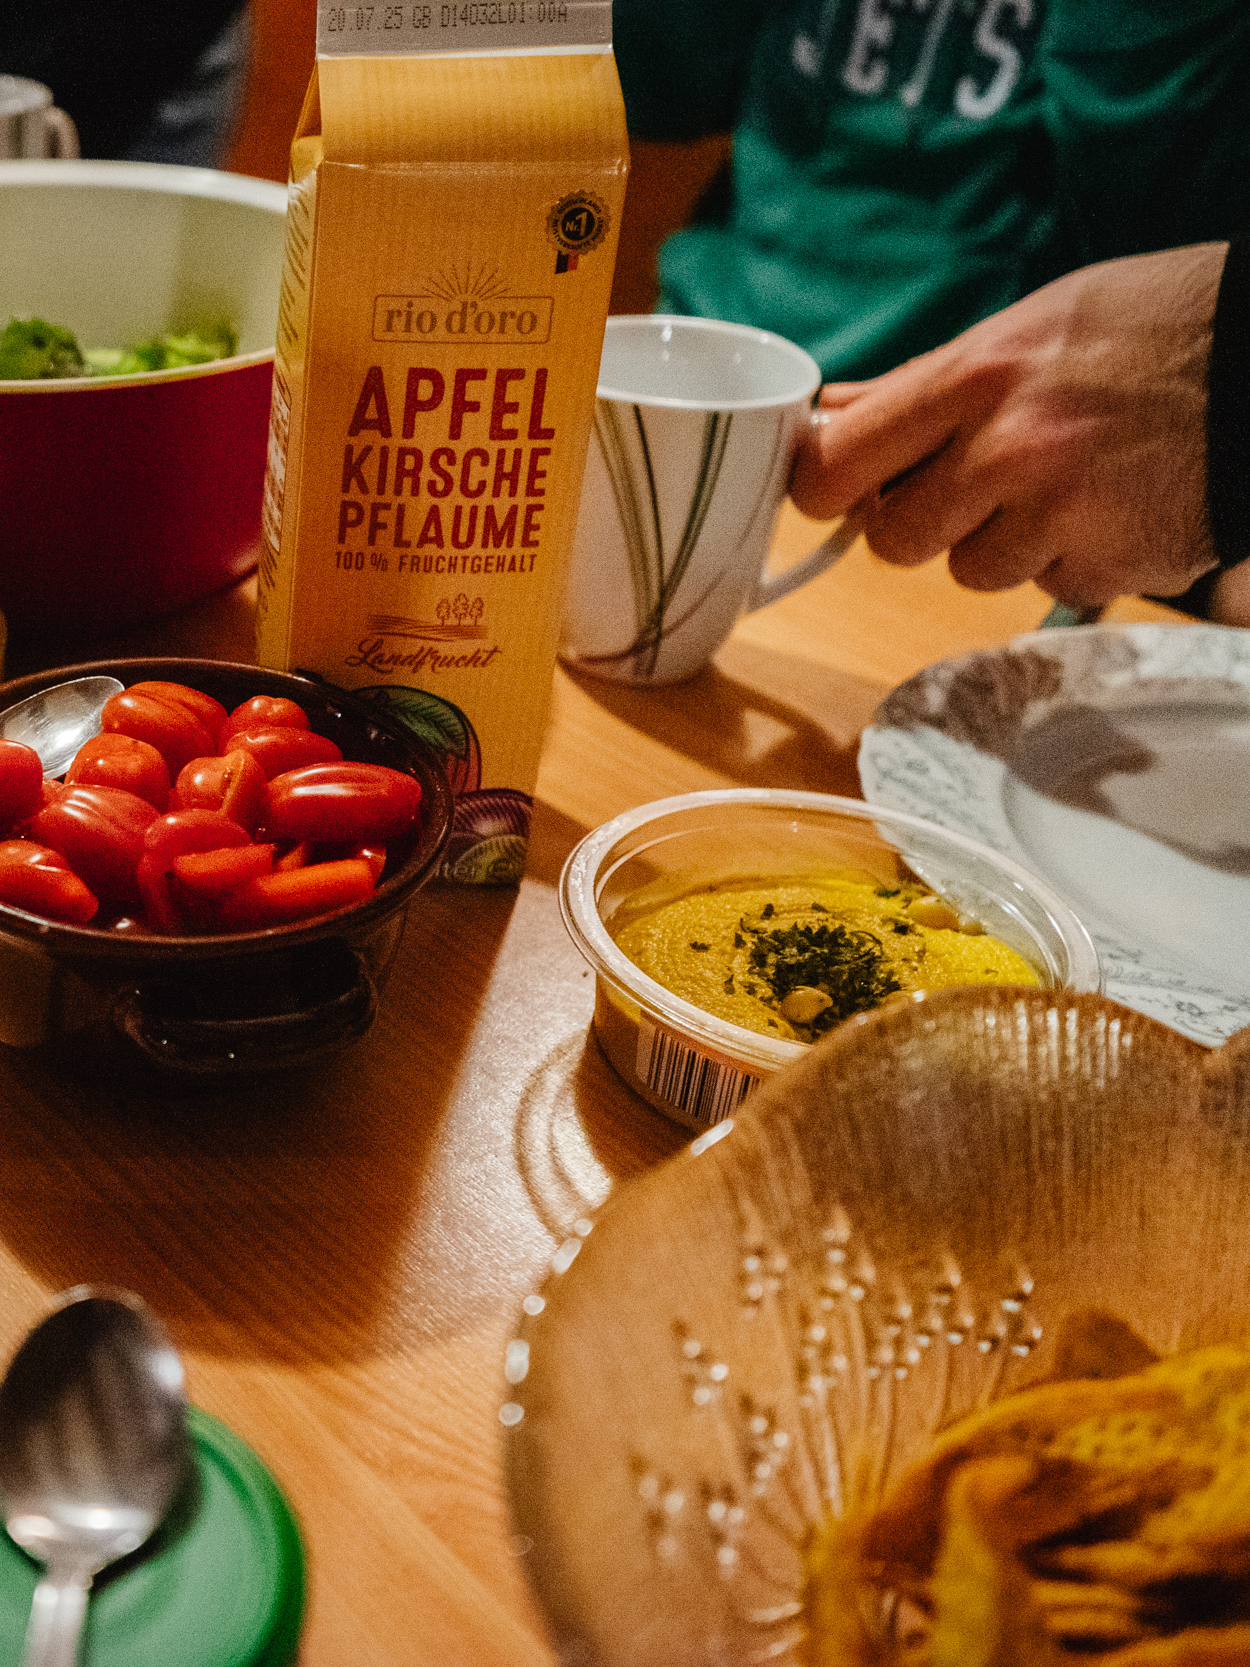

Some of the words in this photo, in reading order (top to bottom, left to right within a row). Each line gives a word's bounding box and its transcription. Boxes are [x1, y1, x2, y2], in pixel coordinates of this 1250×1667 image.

[328, 6, 403, 31] 20.07.25
[413, 5, 431, 28] GB
[382, 301, 437, 334] rio
[445, 301, 538, 335] d'oro
[347, 366, 555, 441] APFEL
[341, 444, 552, 499] KIRSCHE
[337, 501, 545, 551] PFLAUME
[335, 552, 365, 571] 100
[370, 553, 388, 572] %
[399, 554, 538, 574] FRUCHTGEHALT
[345, 639, 503, 674] Landfrucht
